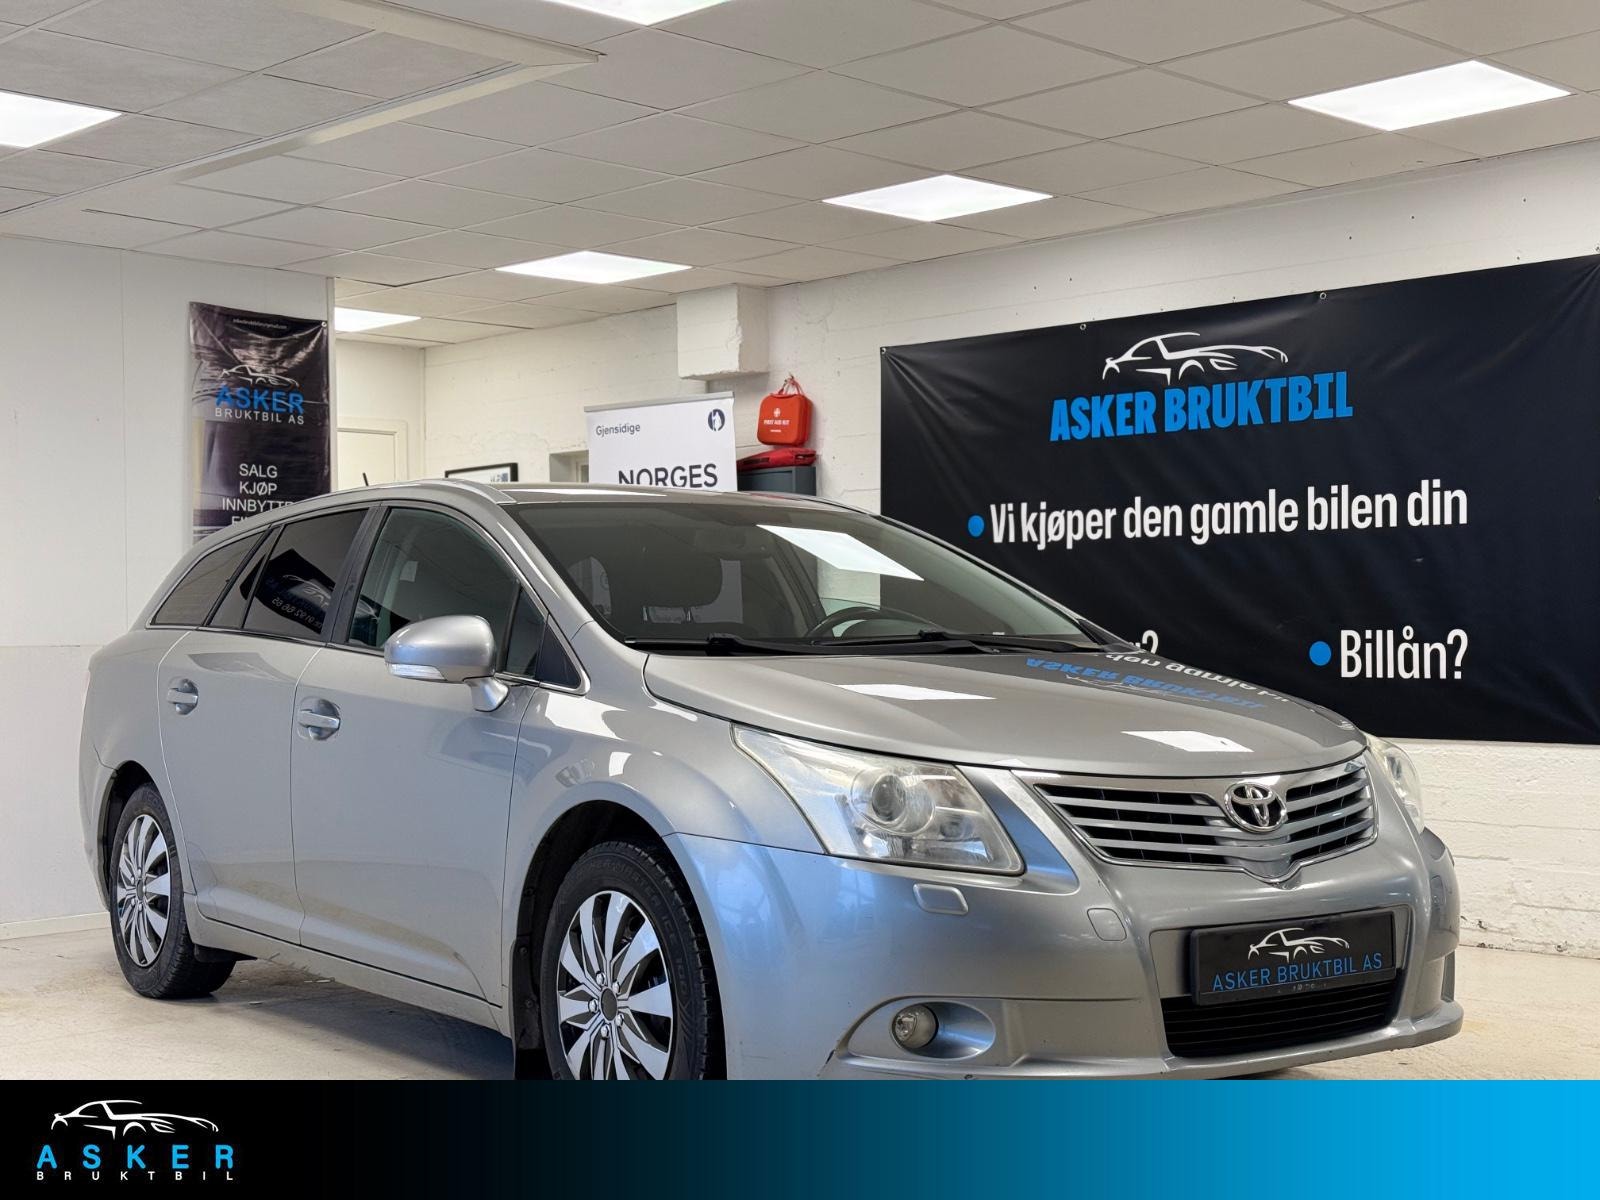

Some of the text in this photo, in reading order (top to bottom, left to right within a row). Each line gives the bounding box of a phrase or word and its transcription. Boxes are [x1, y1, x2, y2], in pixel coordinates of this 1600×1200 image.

[216, 384, 304, 414] ASKER
[1049, 371, 1354, 442] ASKER BRUKTBIL
[215, 407, 304, 425] BRUKTBIL AS
[595, 422, 641, 438] Gjensidige
[239, 463, 278, 479] SALG
[618, 463, 718, 488] NORGES
[239, 481, 278, 497] KJØP
[989, 478, 1468, 551] Vi kjøper den gamle bilen din
[1340, 625, 1468, 680] Billån?
[1212, 967, 1271, 992] ASKER
[1277, 957, 1358, 984] BRUKTBIL
[1362, 952, 1383, 972] AS
